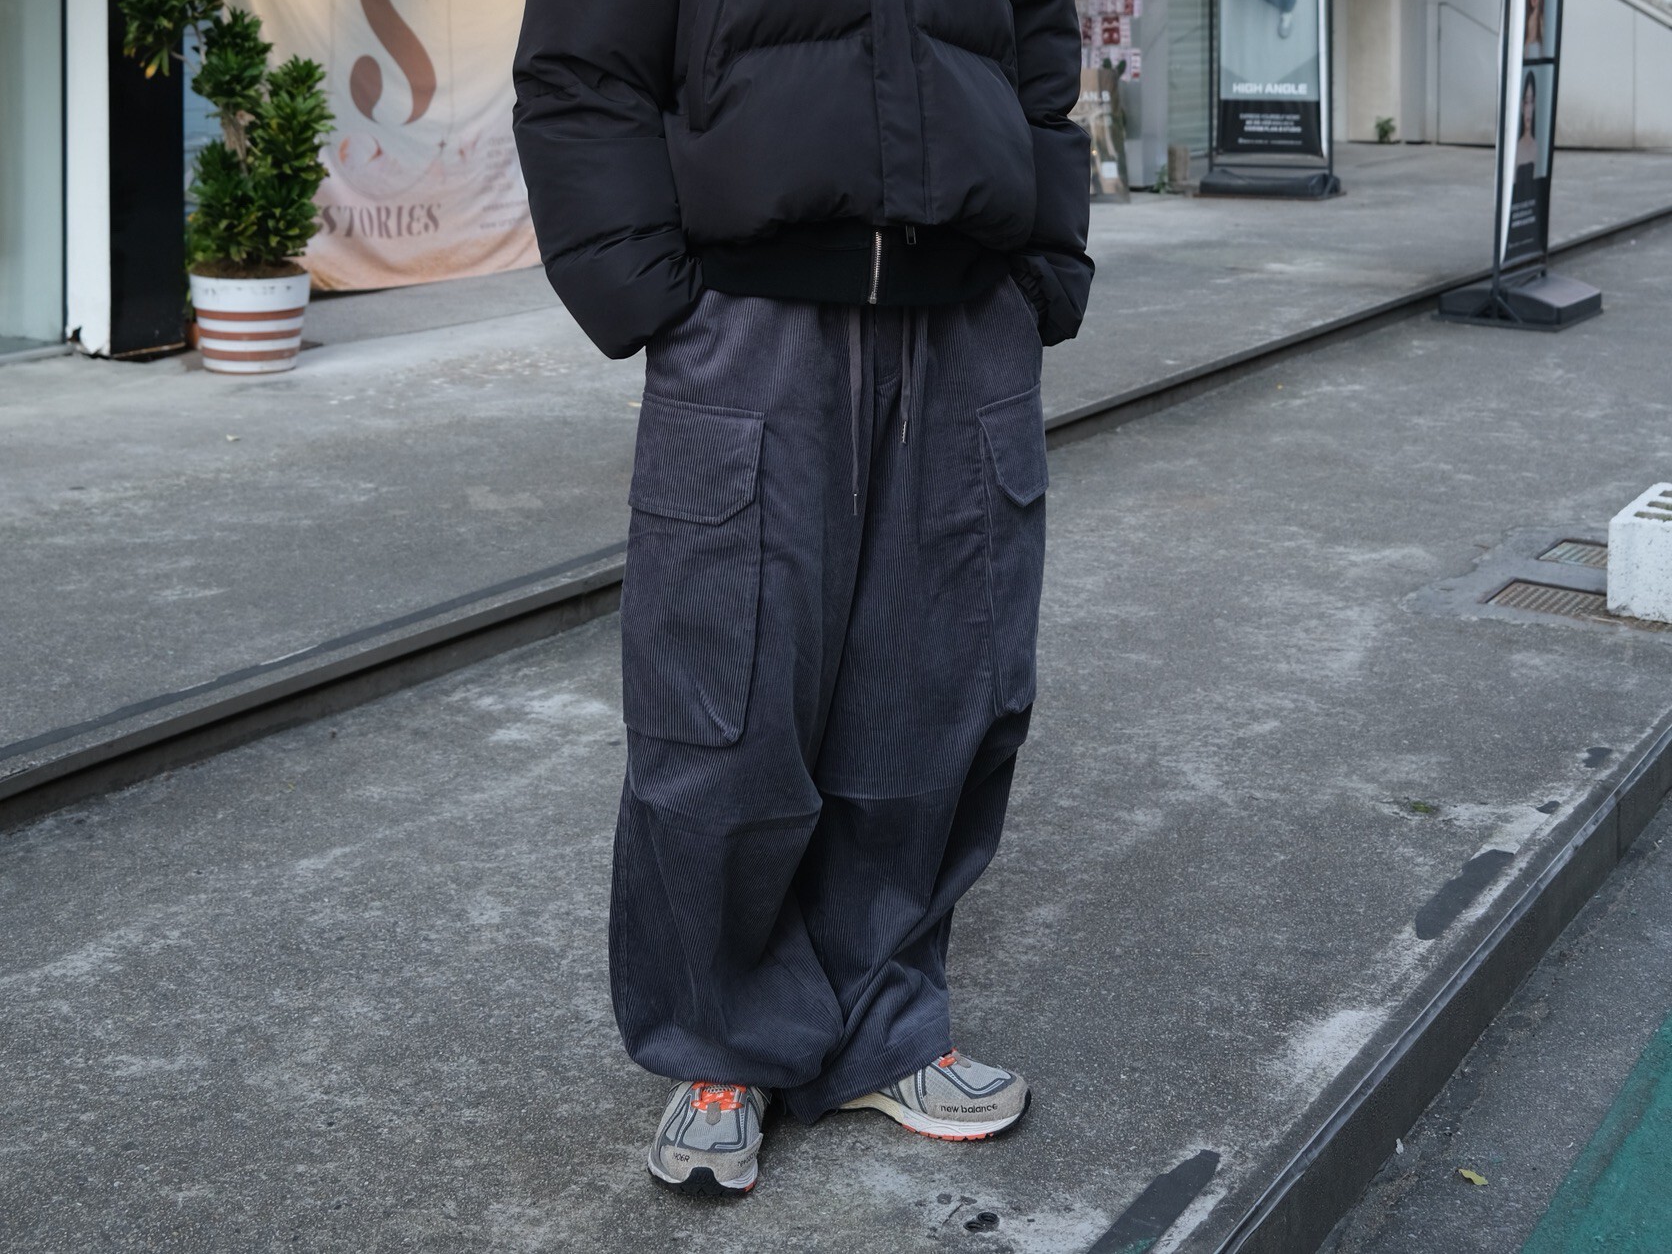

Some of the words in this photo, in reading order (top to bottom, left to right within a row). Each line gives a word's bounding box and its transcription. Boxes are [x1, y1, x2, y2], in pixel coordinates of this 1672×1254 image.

[1232, 82, 1263, 95] HIGH
[1264, 82, 1307, 95] ANGLE
[319, 204, 442, 239] STORIES
[940, 1105, 959, 1113] new
[961, 1103, 998, 1114] balance
